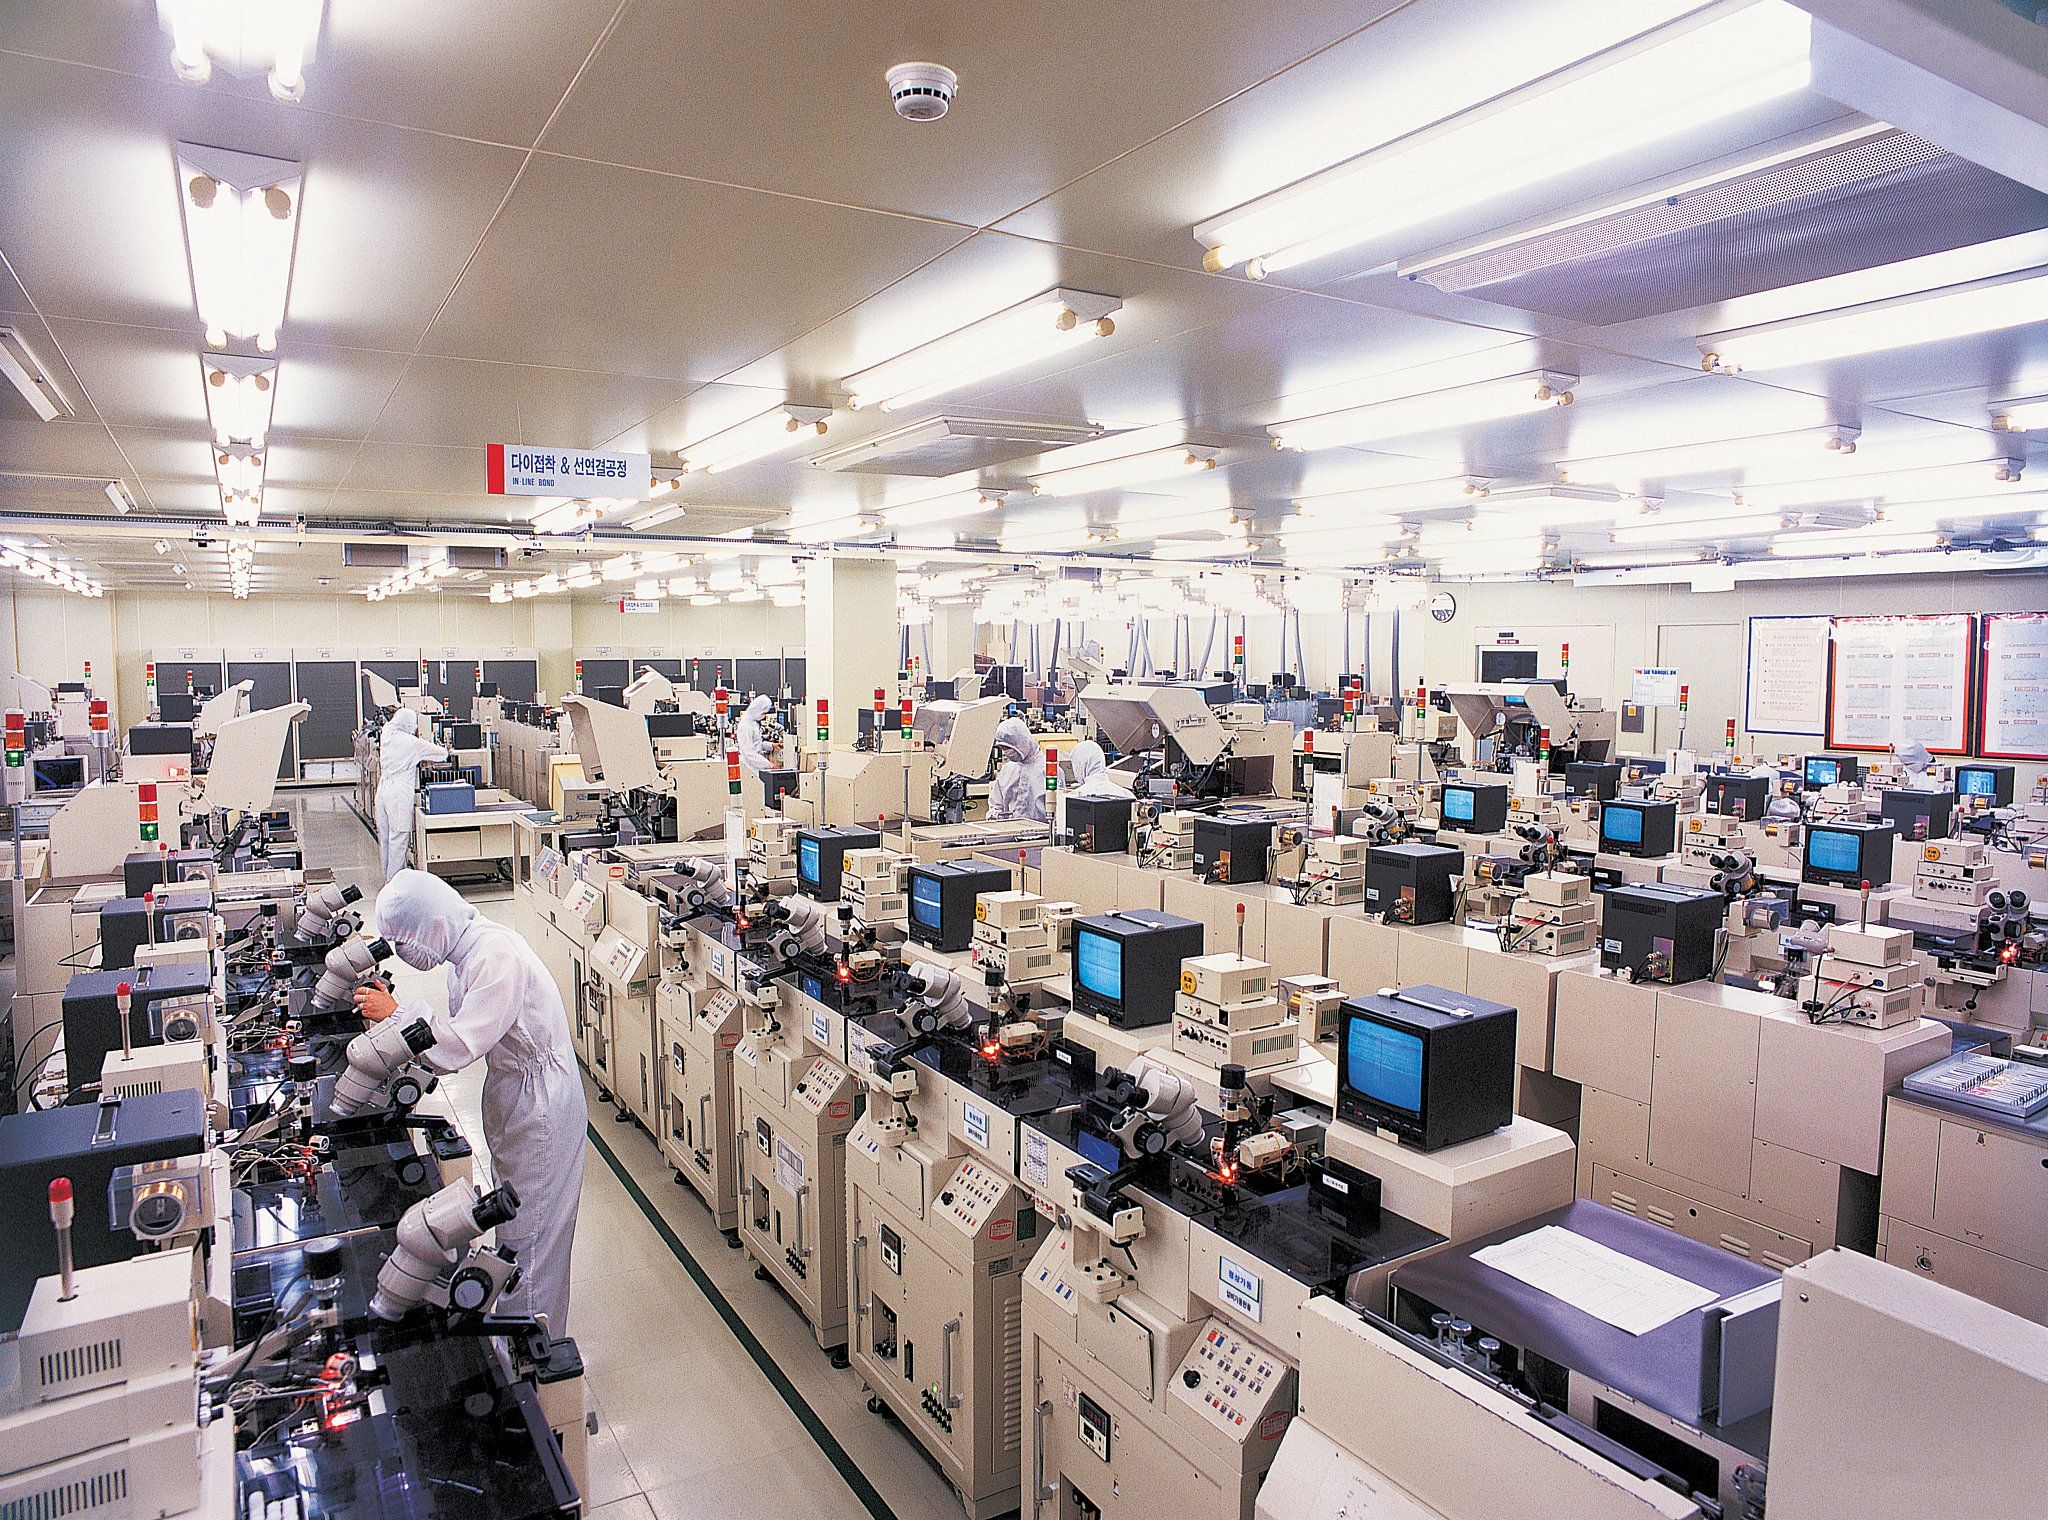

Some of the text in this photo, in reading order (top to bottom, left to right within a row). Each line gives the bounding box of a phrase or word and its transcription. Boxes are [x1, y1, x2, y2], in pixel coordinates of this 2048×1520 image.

[511, 453, 627, 478] 다이접착 & 선연결공정
[538, 478, 555, 487] BOND
